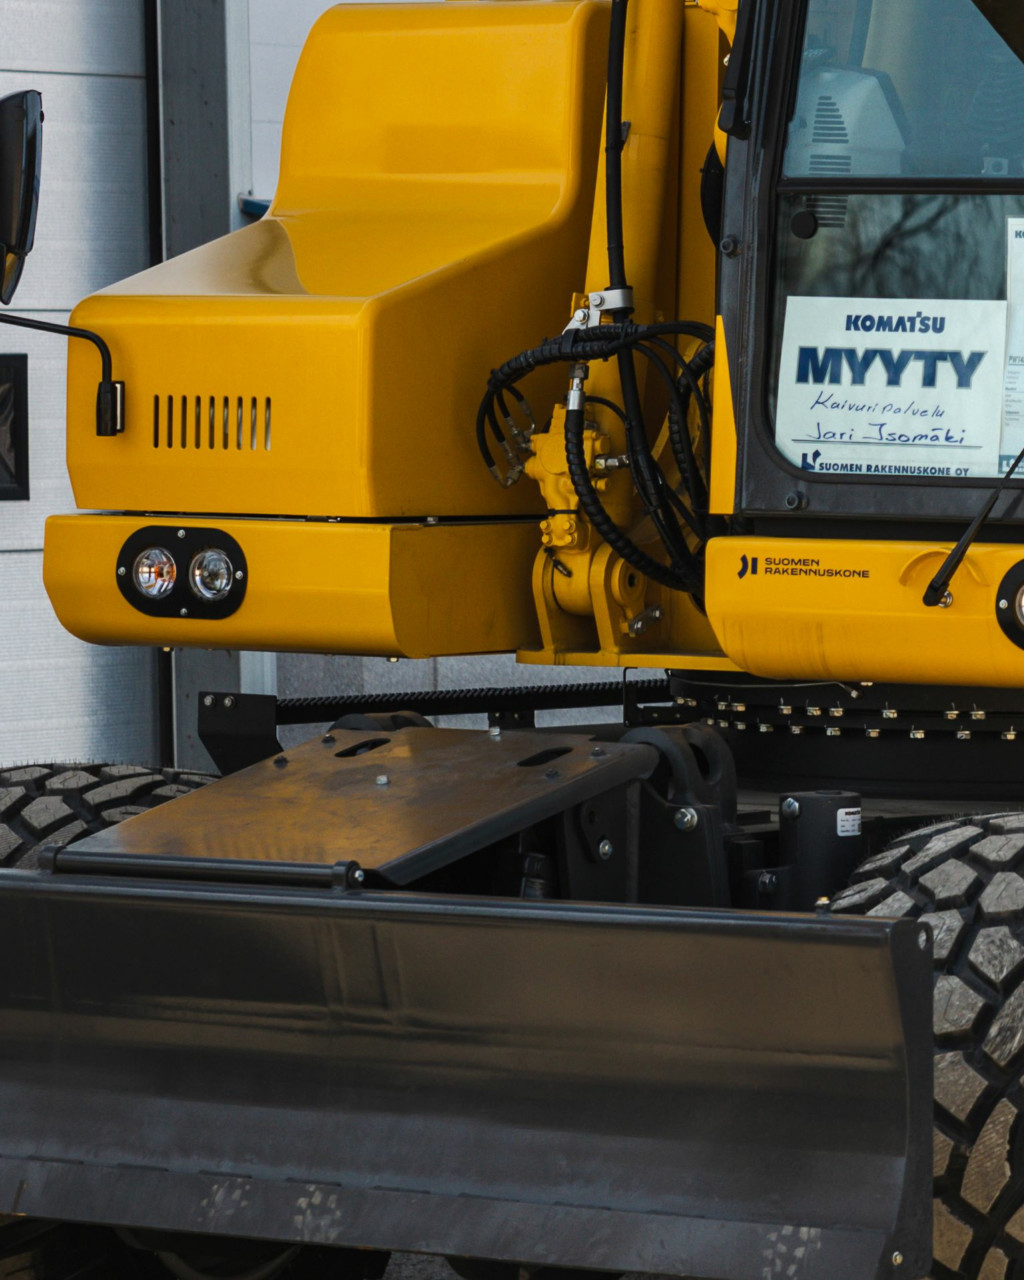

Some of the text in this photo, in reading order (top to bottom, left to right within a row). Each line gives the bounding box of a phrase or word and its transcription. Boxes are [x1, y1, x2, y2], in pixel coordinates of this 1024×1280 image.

[845, 311, 946, 334] KOMATSU
[795, 345, 989, 389] MYYTY
[805, 422, 855, 441] Jari
[818, 462, 969, 477] SUOMEN RAKENNUSKONE OY
[764, 557, 820, 567] SUOMEN
[764, 567, 869, 578] RAKENNUSKONE
